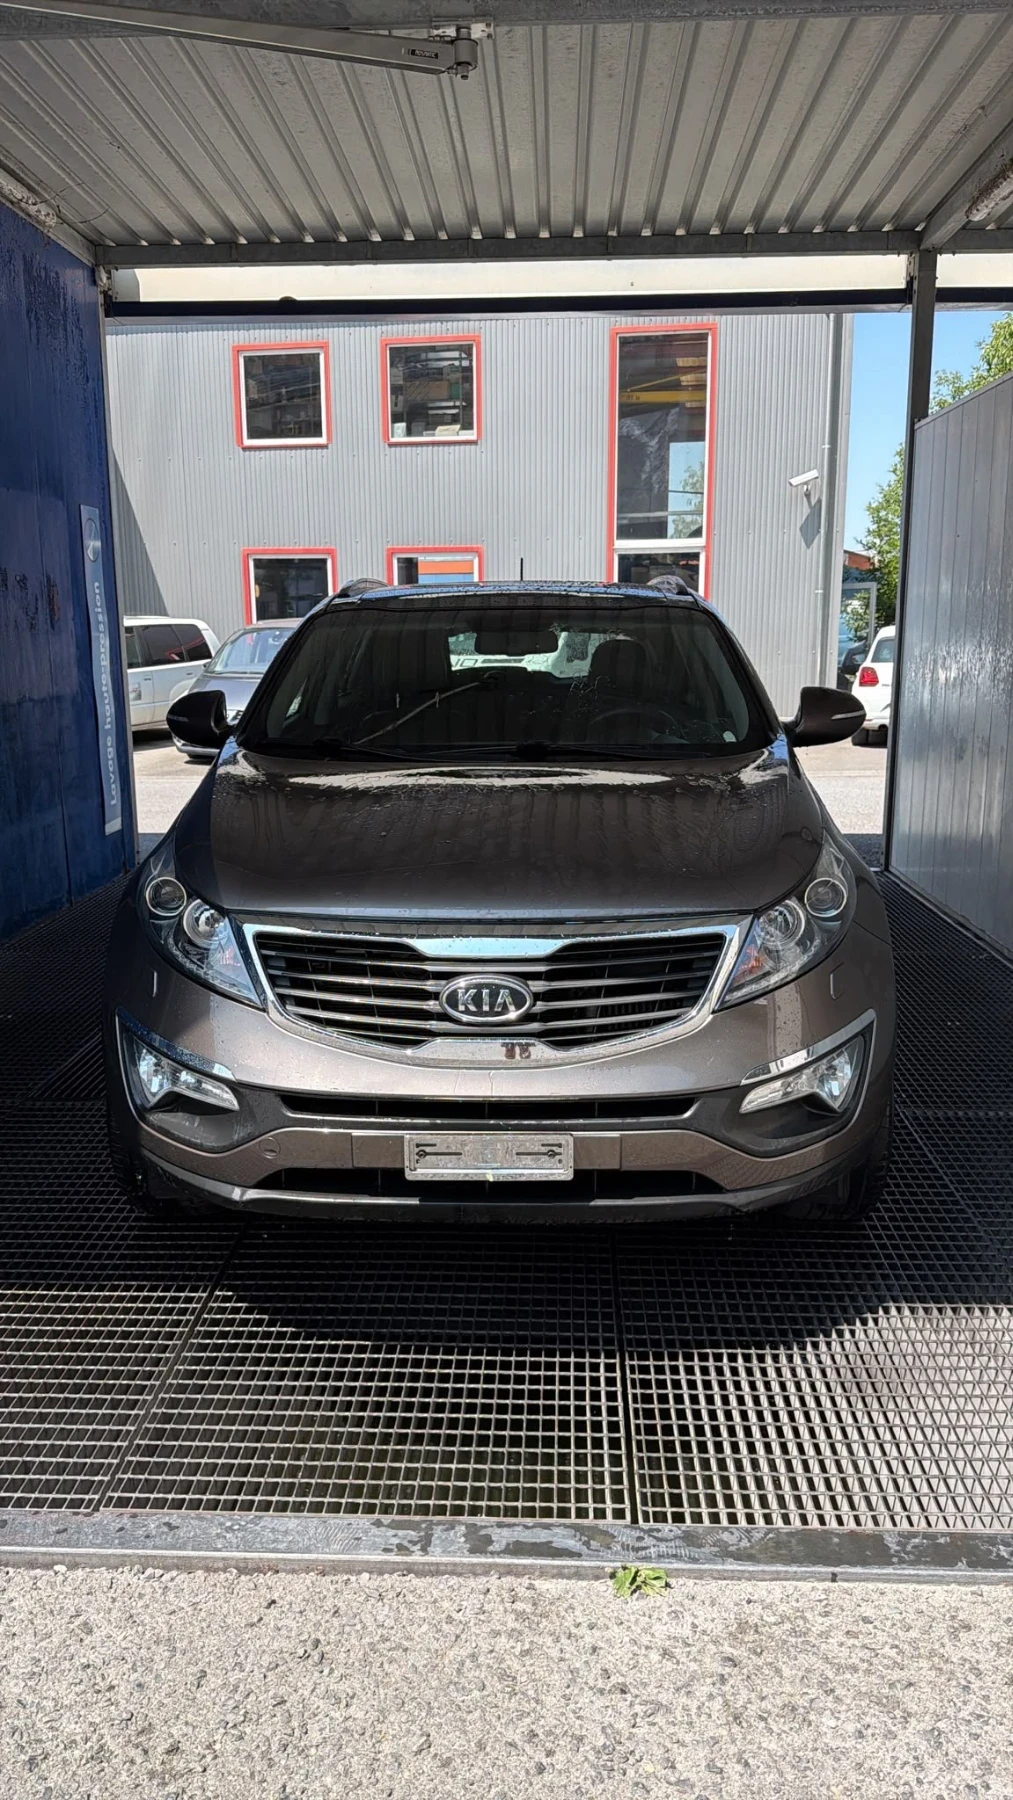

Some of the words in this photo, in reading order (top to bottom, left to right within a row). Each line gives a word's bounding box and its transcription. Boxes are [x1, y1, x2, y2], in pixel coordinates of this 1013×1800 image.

[94, 581, 112, 729] haute-pression
[106, 735, 117, 805] Lavage
[456, 988, 516, 1012] KIA
